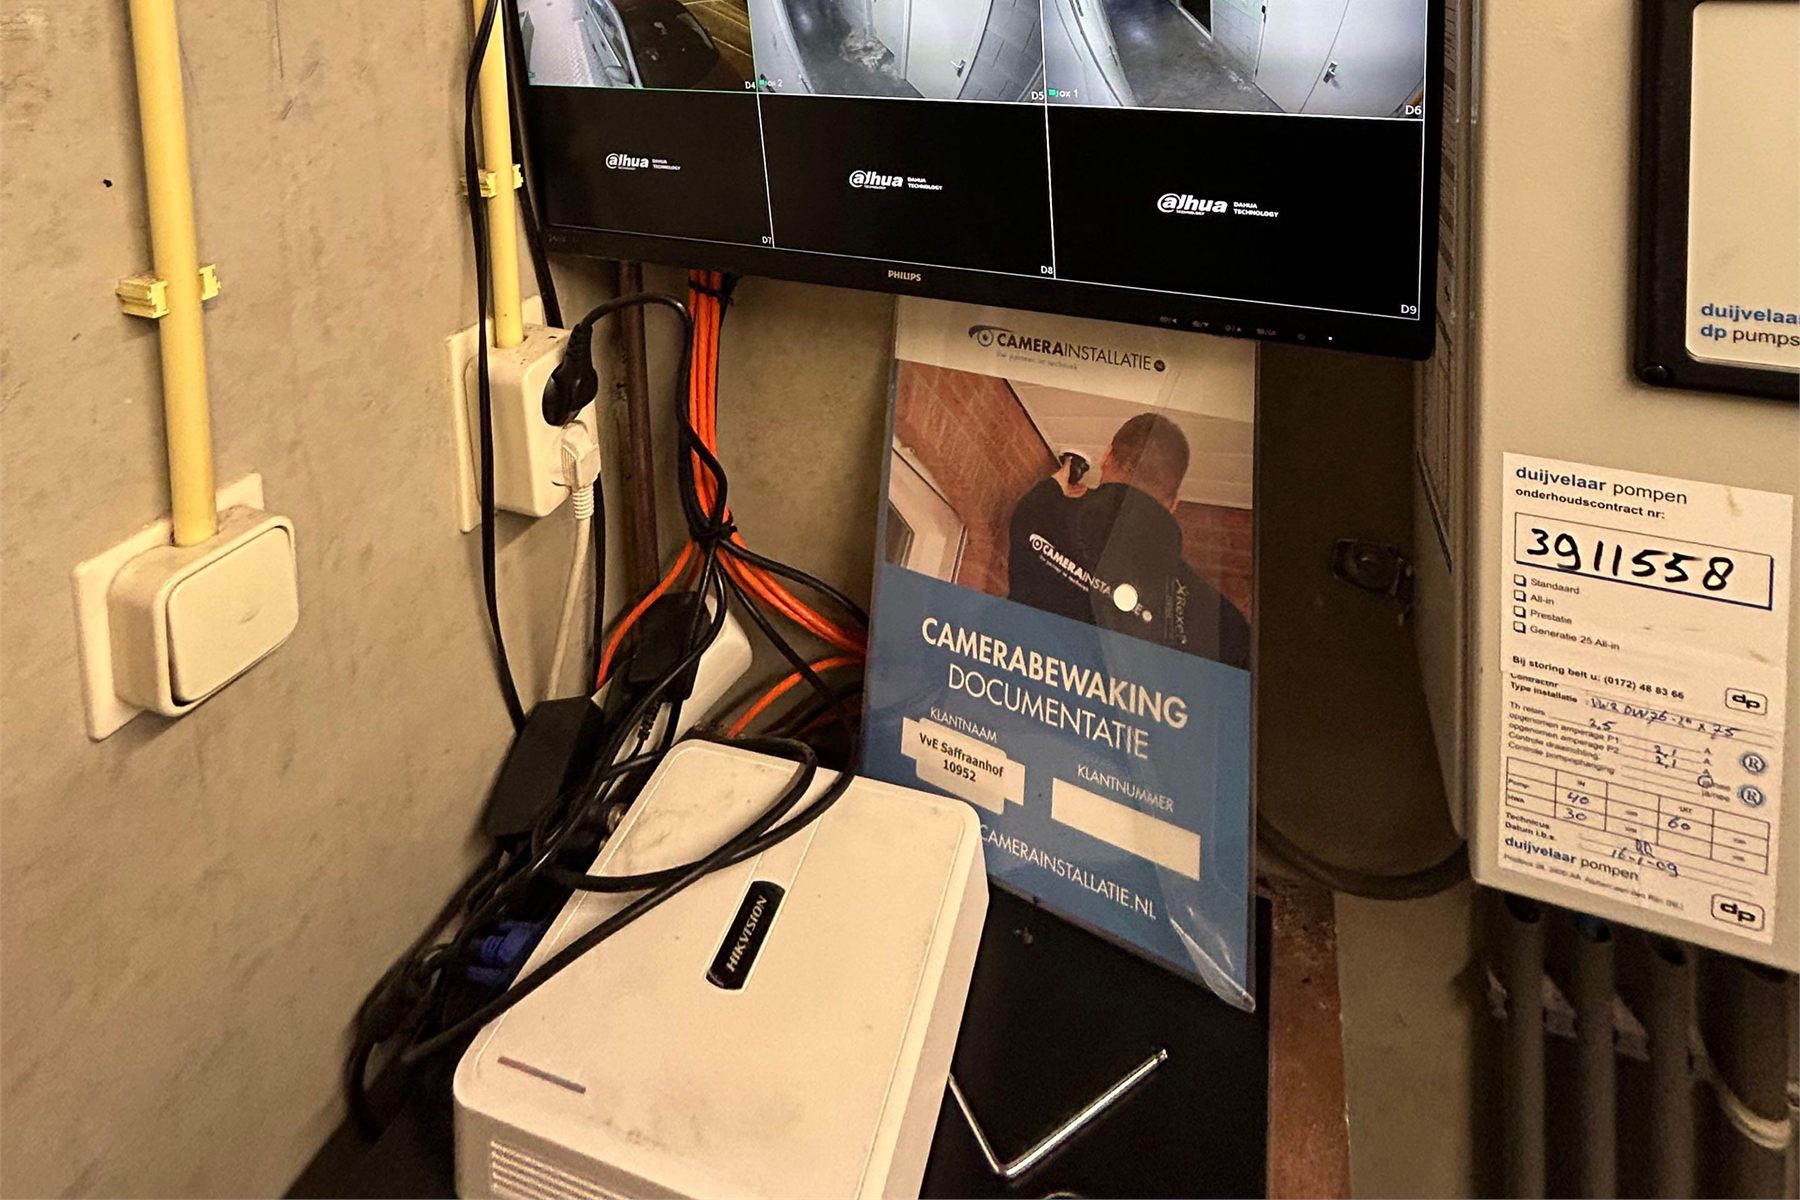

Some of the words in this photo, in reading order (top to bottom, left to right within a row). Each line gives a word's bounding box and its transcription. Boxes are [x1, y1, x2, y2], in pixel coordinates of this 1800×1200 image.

[744, 81, 756, 90] D4
[1031, 91, 1044, 101] D5
[1405, 105, 1422, 116] D6
[1233, 201, 1258, 209] DAHUA
[1233, 208, 1279, 218] TECHNOLOGY
[761, 235, 772, 245] D7
[887, 269, 922, 282] PHILIPS
[1040, 266, 1053, 275] D8
[1400, 304, 1417, 316] D9
[1701, 303, 1800, 324] duijvelaa
[1700, 324, 1727, 341] dp
[1733, 329, 1800, 348] pumps
[996, 332, 1152, 371] CAMERAINSTALLATIE
[1515, 466, 1607, 492] duijvelaar
[1613, 481, 1688, 504] pompen
[1515, 488, 1644, 517] onderhoudscontract
[1647, 508, 1666, 520] nr:
[1526, 527, 1735, 591] 3911558
[1530, 578, 1580, 595] Standaard
[1530, 594, 1555, 606] All-in
[1530, 609, 1573, 625] Prestatie
[1530, 625, 1577, 642] Generatie
[1579, 635, 1593, 645] 25
[1594, 639, 1620, 651] All-in
[921, 617, 1189, 729] CAMERABEWAKING
[1512, 655, 1526, 667] Bij
[1529, 660, 1565, 676] storing
[1568, 667, 1588, 680] belt
[1604, 674, 1637, 692] (0172)
[1510, 681, 1532, 694] Type
[1732, 693, 1761, 710] dp
[948, 664, 1151, 761] DOCUMENTATIE
[930, 707, 998, 743] KLANTNAAM
[919, 732, 939, 749] VvE
[940, 742, 1004, 778] Saffraanhof
[943, 759, 977, 783] 10952
[1077, 764, 1175, 813] KLANTNUMMER
[1567, 791, 1590, 805] 40
[1505, 811, 1550, 830] Technicus
[1565, 807, 1587, 821] 30
[1667, 815, 1691, 830] 60
[1504, 821, 1534, 837] Datum
[1504, 836, 1577, 864] duijvelaar
[1580, 855, 1640, 883] pompen
[980, 824, 1157, 921] CAMERAINSTALLATIE.NL
[1720, 903, 1756, 922] dp
[726, 894, 768, 973] HIKVISION
